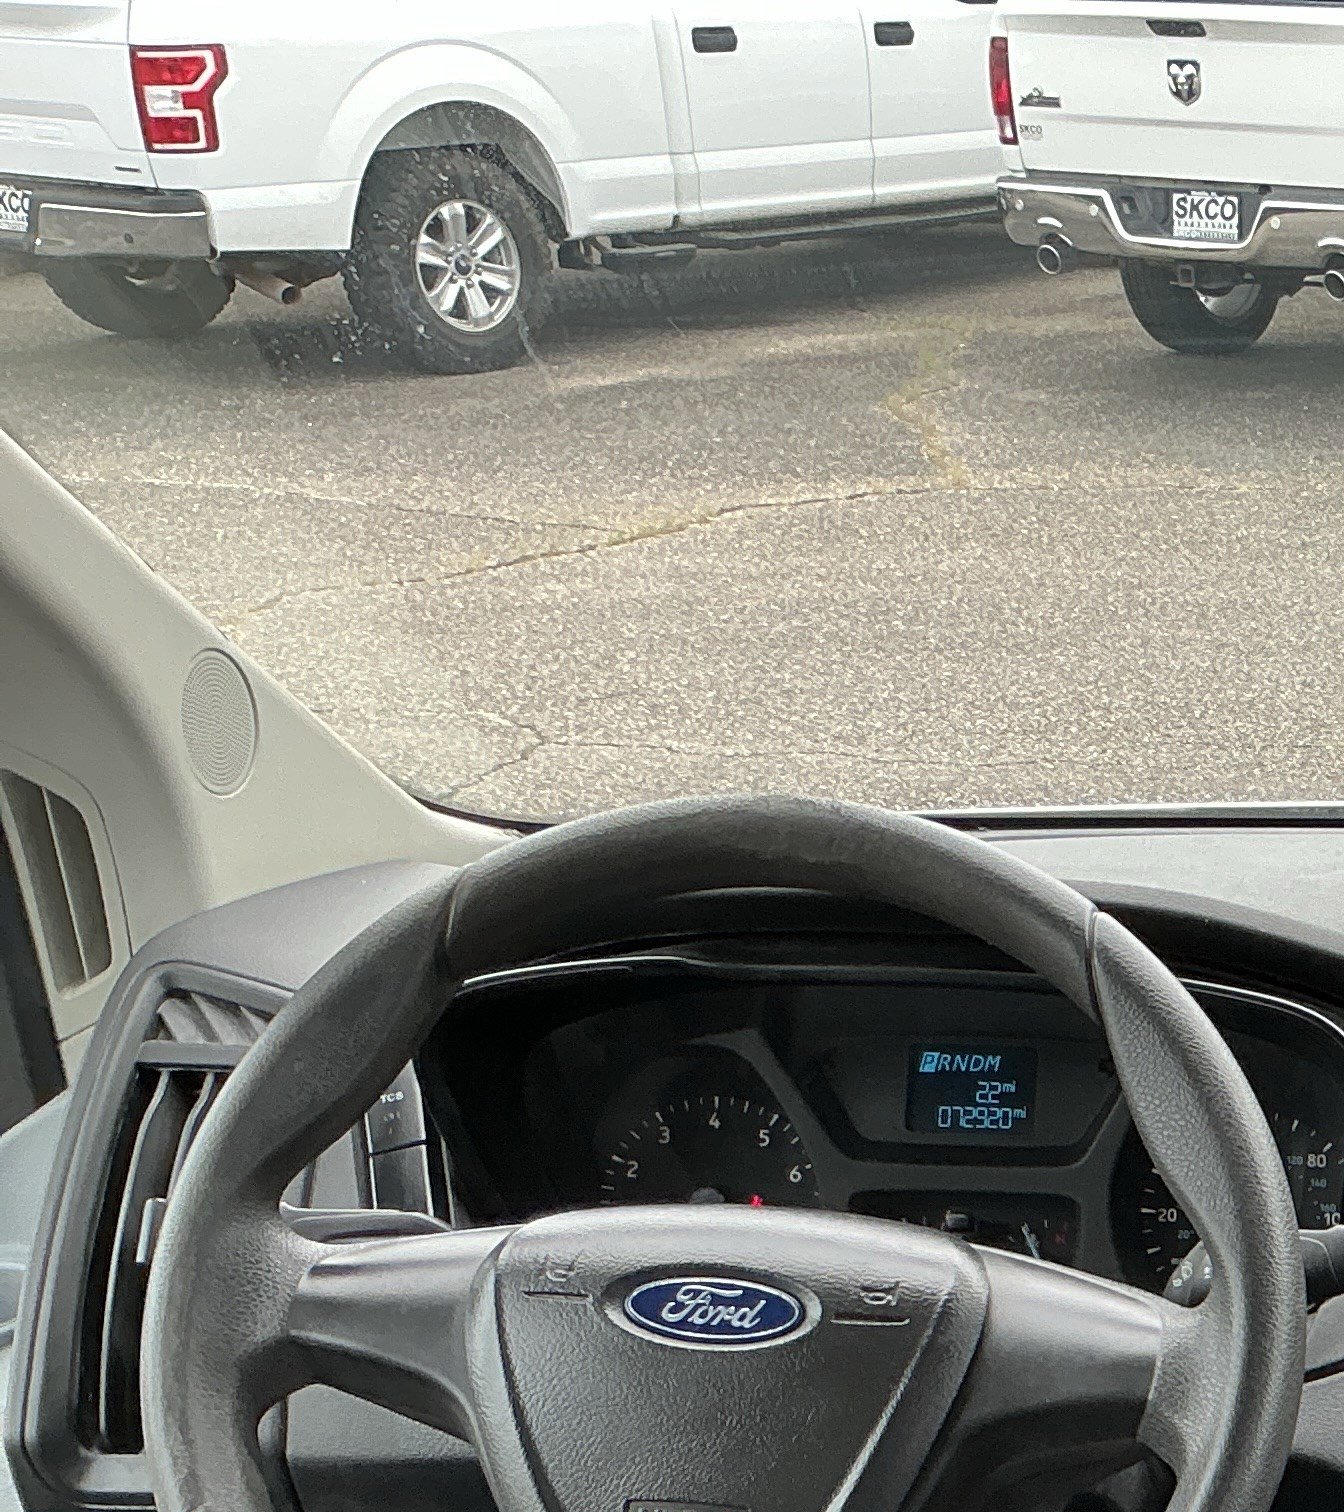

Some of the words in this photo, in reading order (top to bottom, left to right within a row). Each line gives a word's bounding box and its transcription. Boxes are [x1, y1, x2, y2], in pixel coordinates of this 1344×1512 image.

[1175, 196, 1237, 221] SKCO
[709, 1112, 721, 1129] 4
[938, 1106, 1012, 1129] 072920
[658, 1126, 670, 1144] 3
[759, 1129, 770, 1147] 5
[627, 1160, 639, 1178] 2
[1307, 1154, 1327, 1168] 80
[789, 1165, 802, 1183] 6
[1157, 1208, 1177, 1223] 20
[661, 1284, 767, 1327] Ford
